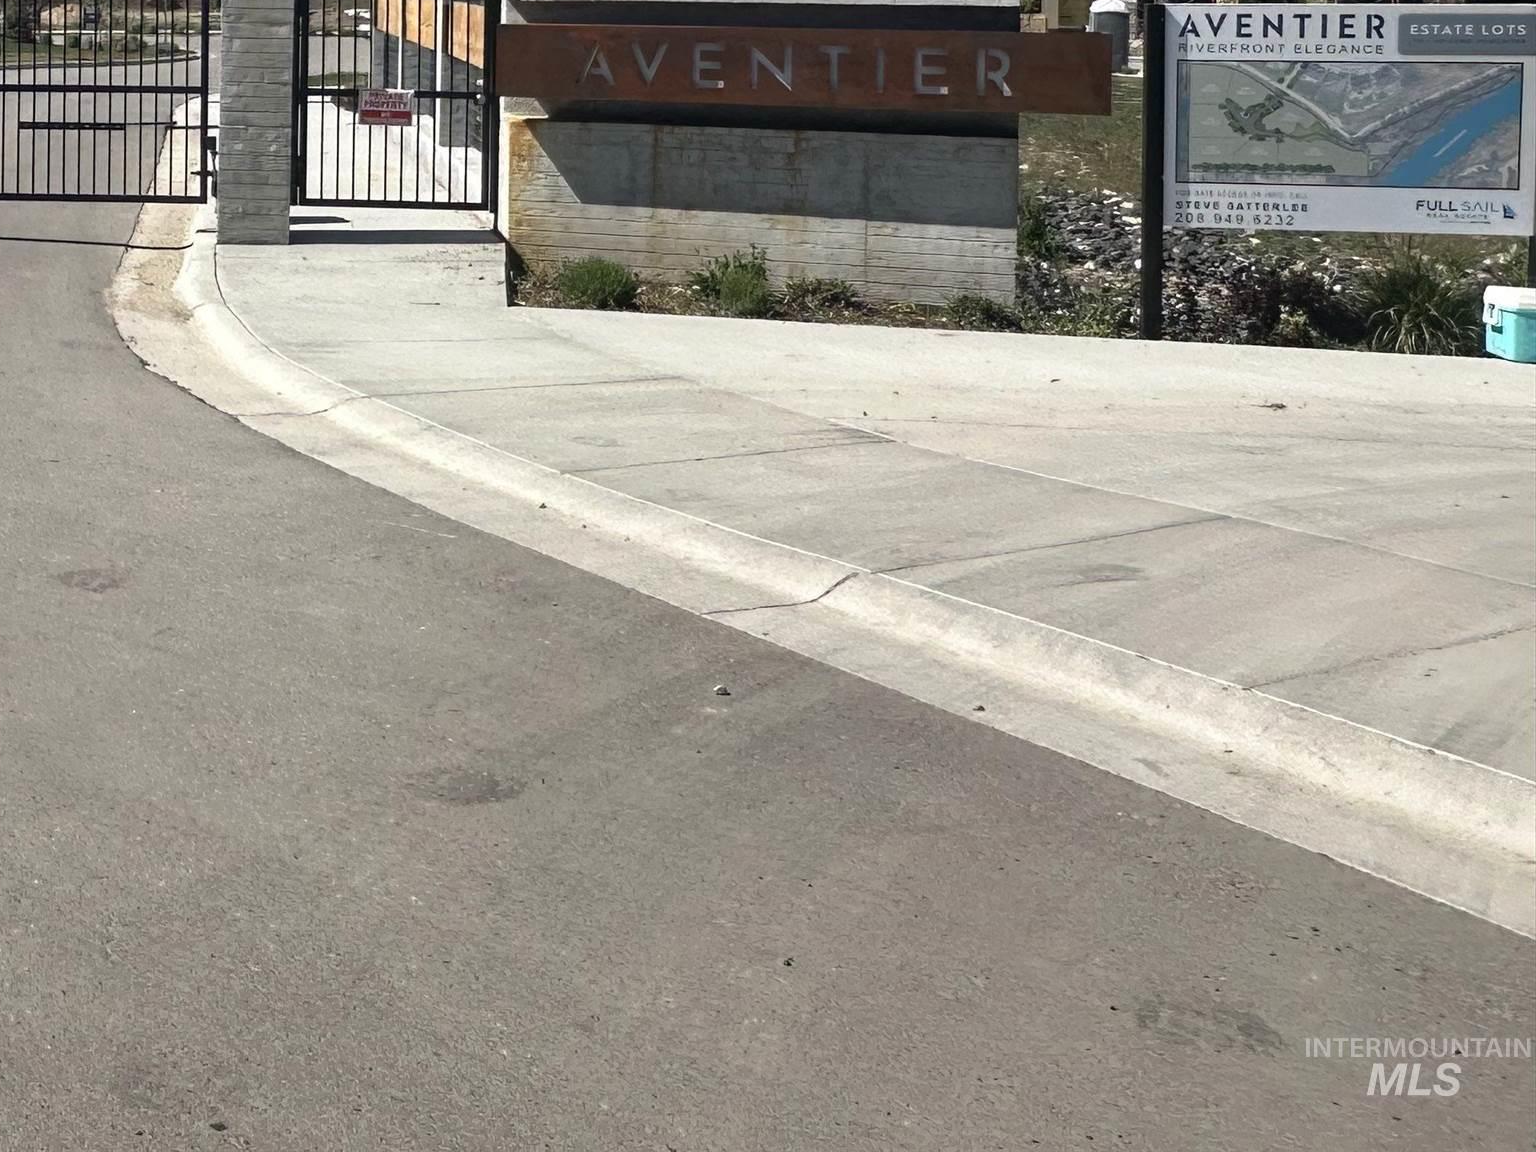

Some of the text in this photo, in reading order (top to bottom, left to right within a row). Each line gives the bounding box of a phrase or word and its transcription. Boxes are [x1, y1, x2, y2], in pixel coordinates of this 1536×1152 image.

[1180, 14, 1385, 38] AVENTIER
[1410, 24, 1527, 35] ESTATE LOTS
[1178, 43, 1384, 55] RIVERFRONT ELEGANCE
[576, 41, 1012, 97] AVENTIER
[1175, 201, 1220, 209] STEVE
[1416, 200, 1499, 212] FULL SAIL
